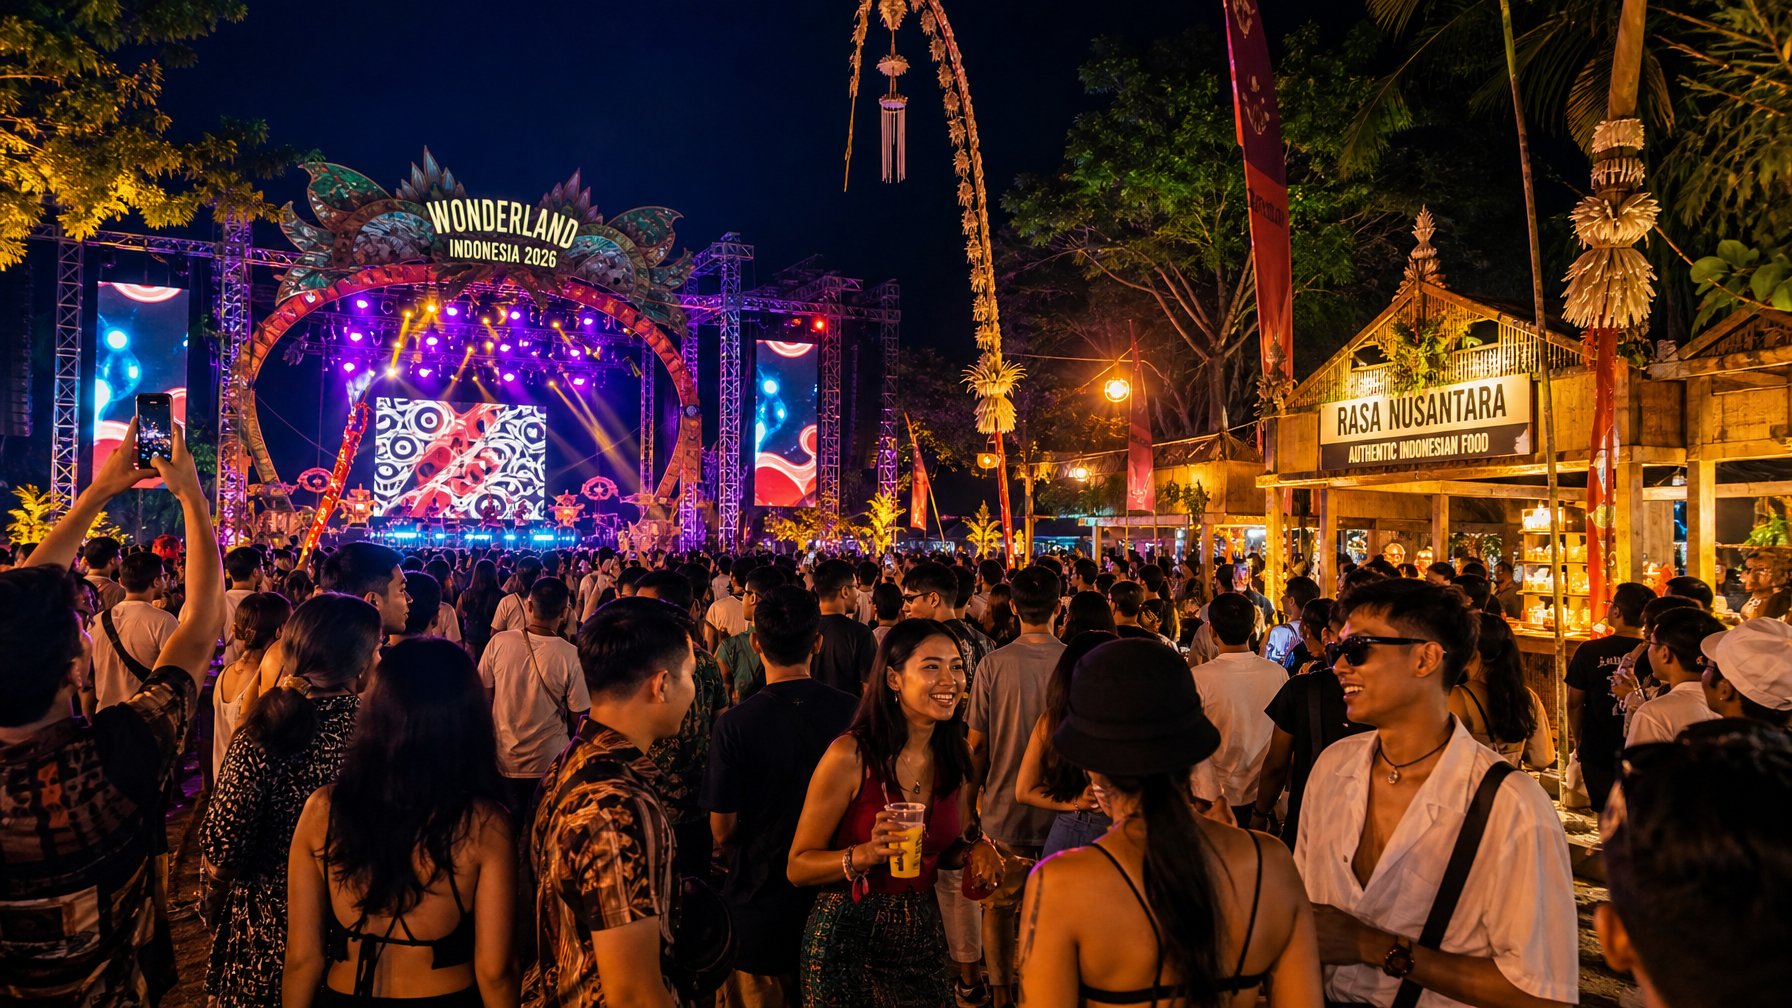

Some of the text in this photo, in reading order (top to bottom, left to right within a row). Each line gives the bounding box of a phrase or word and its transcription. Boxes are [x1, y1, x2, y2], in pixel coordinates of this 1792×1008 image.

[426, 198, 579, 249] WONDERLAND
[449, 239, 557, 268] INDONESIA 2026
[1337, 383, 1507, 436] RASA NUSANTARA
[1348, 432, 1489, 463] AUTHENTIC INDONESIAN FOOD
